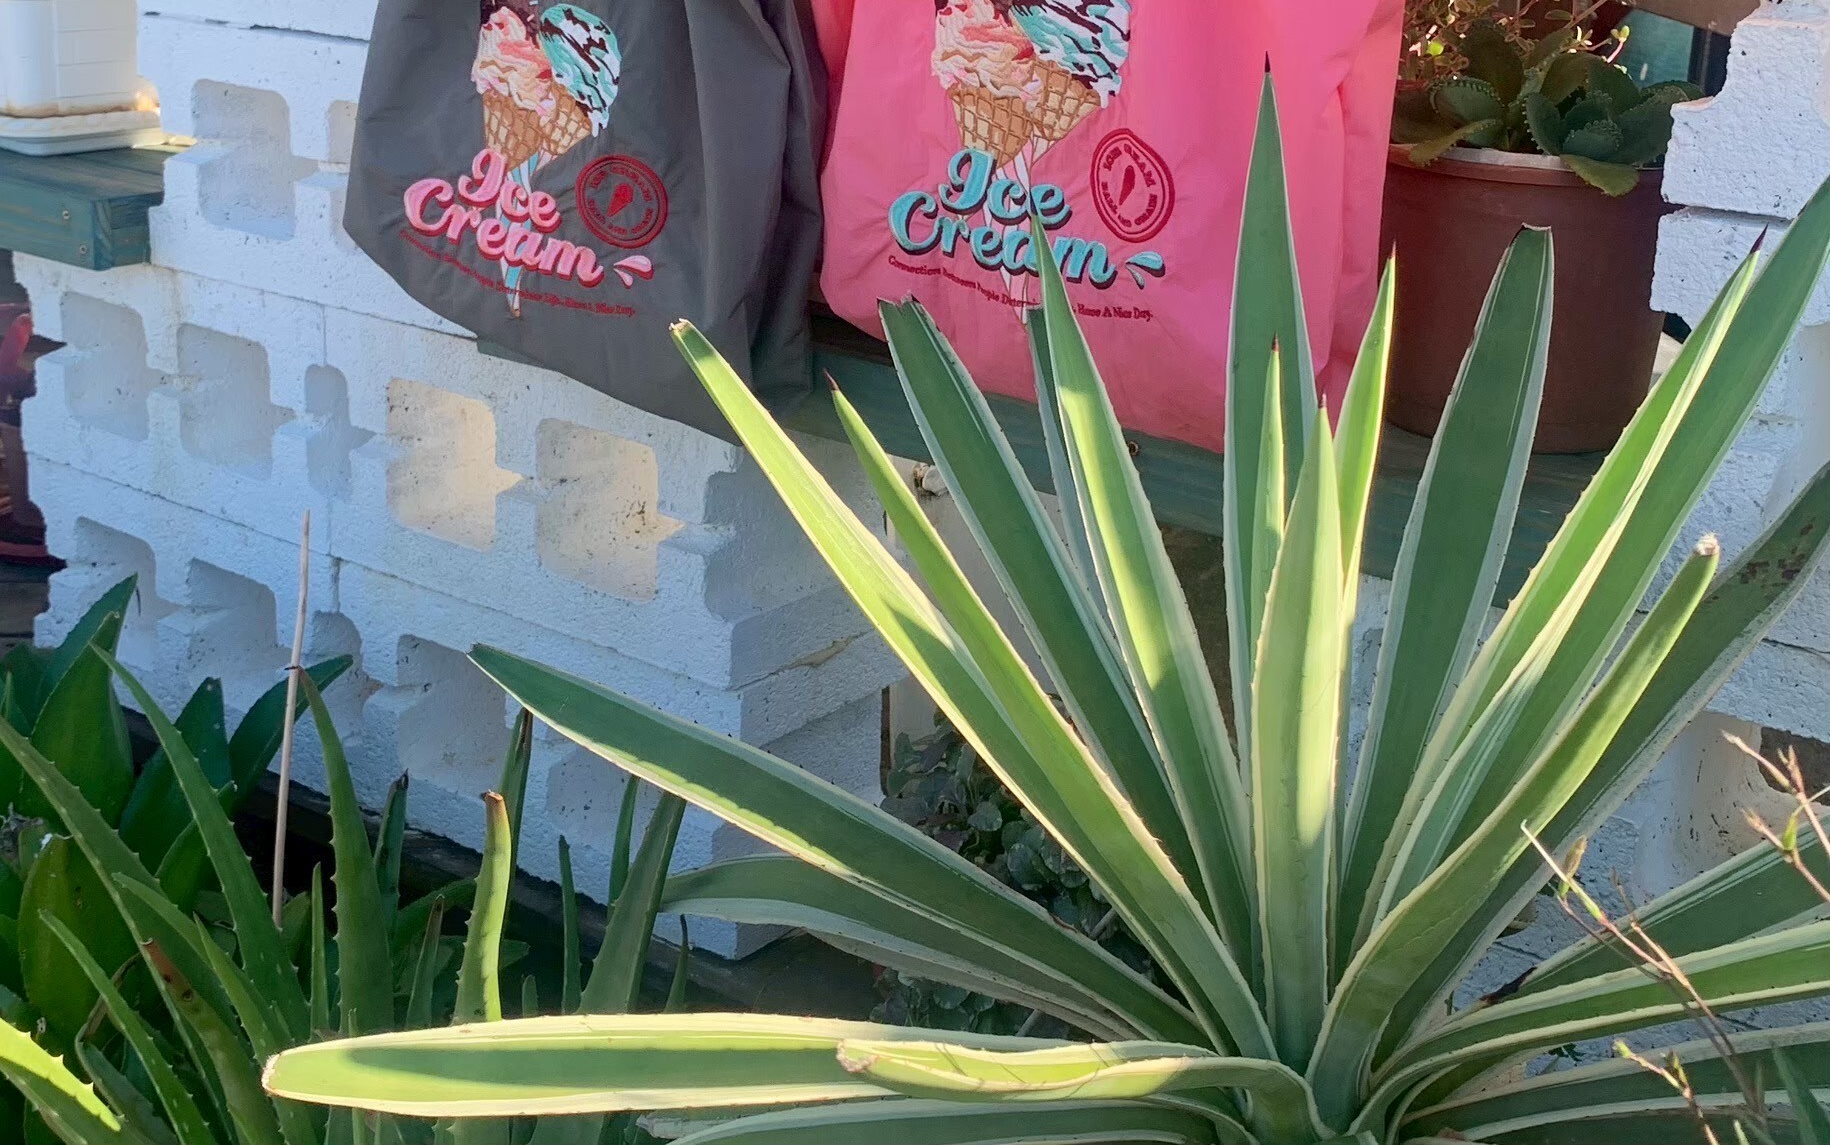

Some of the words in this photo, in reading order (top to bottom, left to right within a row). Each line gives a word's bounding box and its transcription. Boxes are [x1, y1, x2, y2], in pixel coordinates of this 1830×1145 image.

[403, 178, 605, 288] Cream
[457, 148, 563, 234] Ice
[937, 146, 1073, 230] Ice
[887, 190, 1118, 290] Cream
